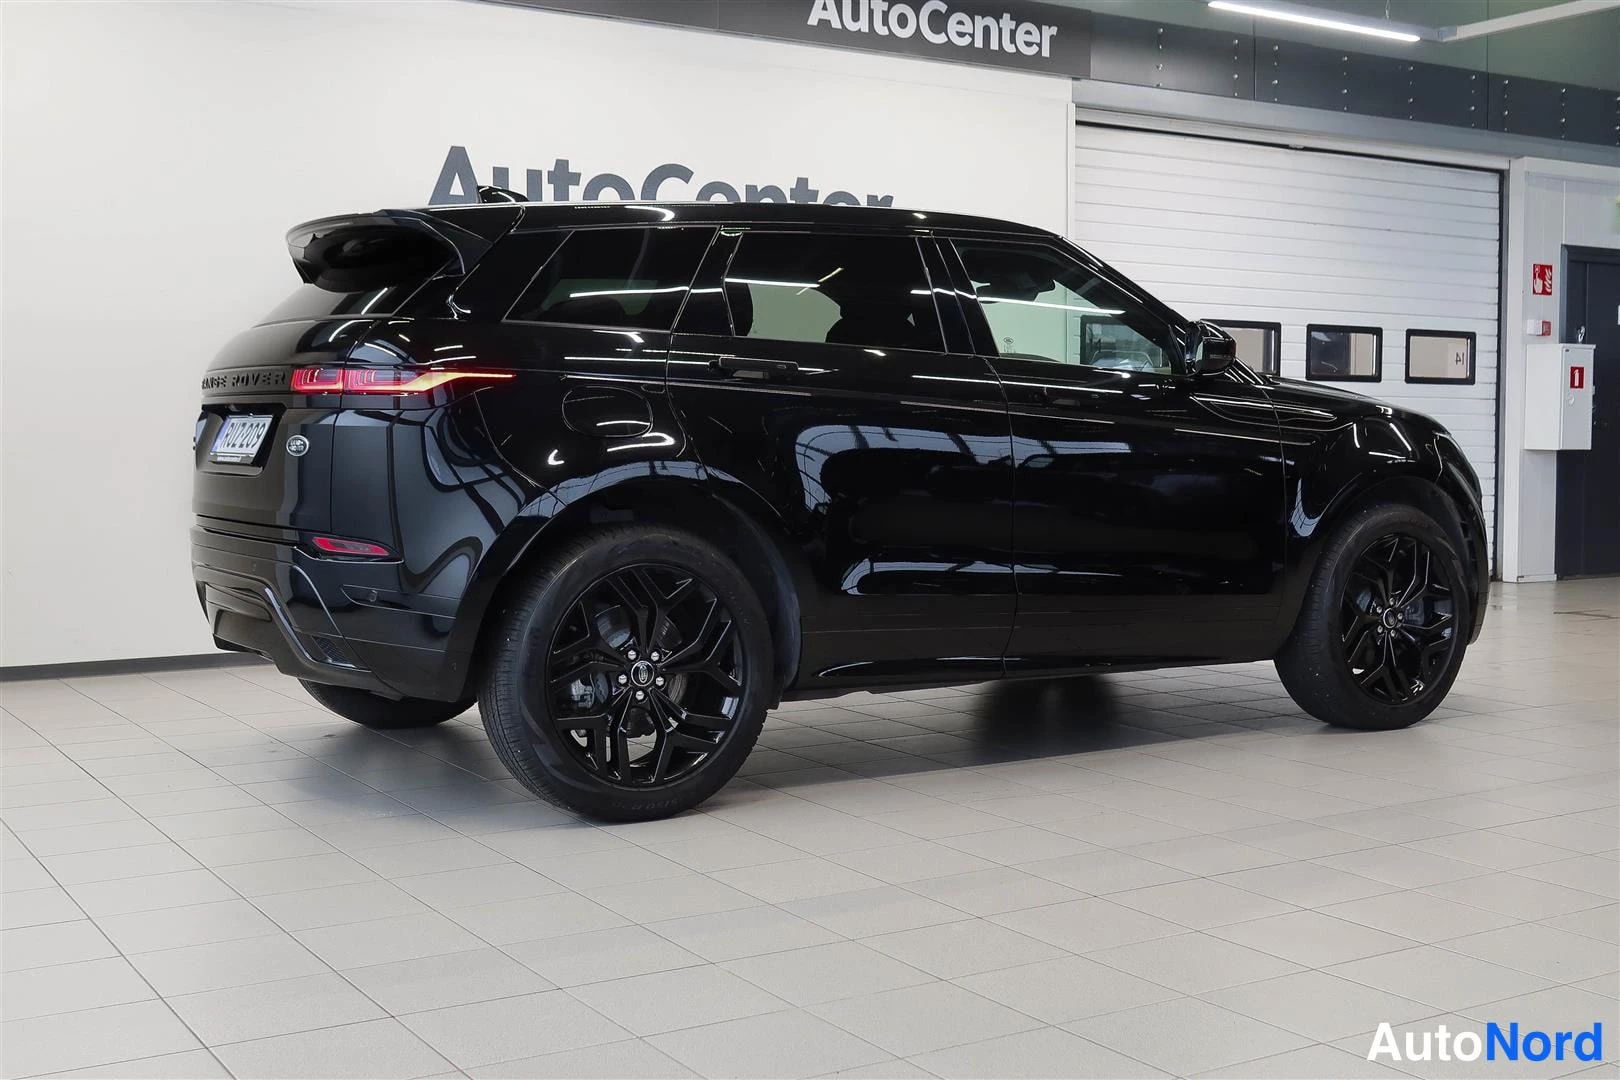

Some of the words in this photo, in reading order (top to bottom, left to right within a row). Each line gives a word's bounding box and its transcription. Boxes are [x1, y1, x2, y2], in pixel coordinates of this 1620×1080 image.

[807, 0, 1058, 58] AutoCenter
[232, 372, 286, 387] ROVER
[220, 422, 267, 449] RUZ-209
